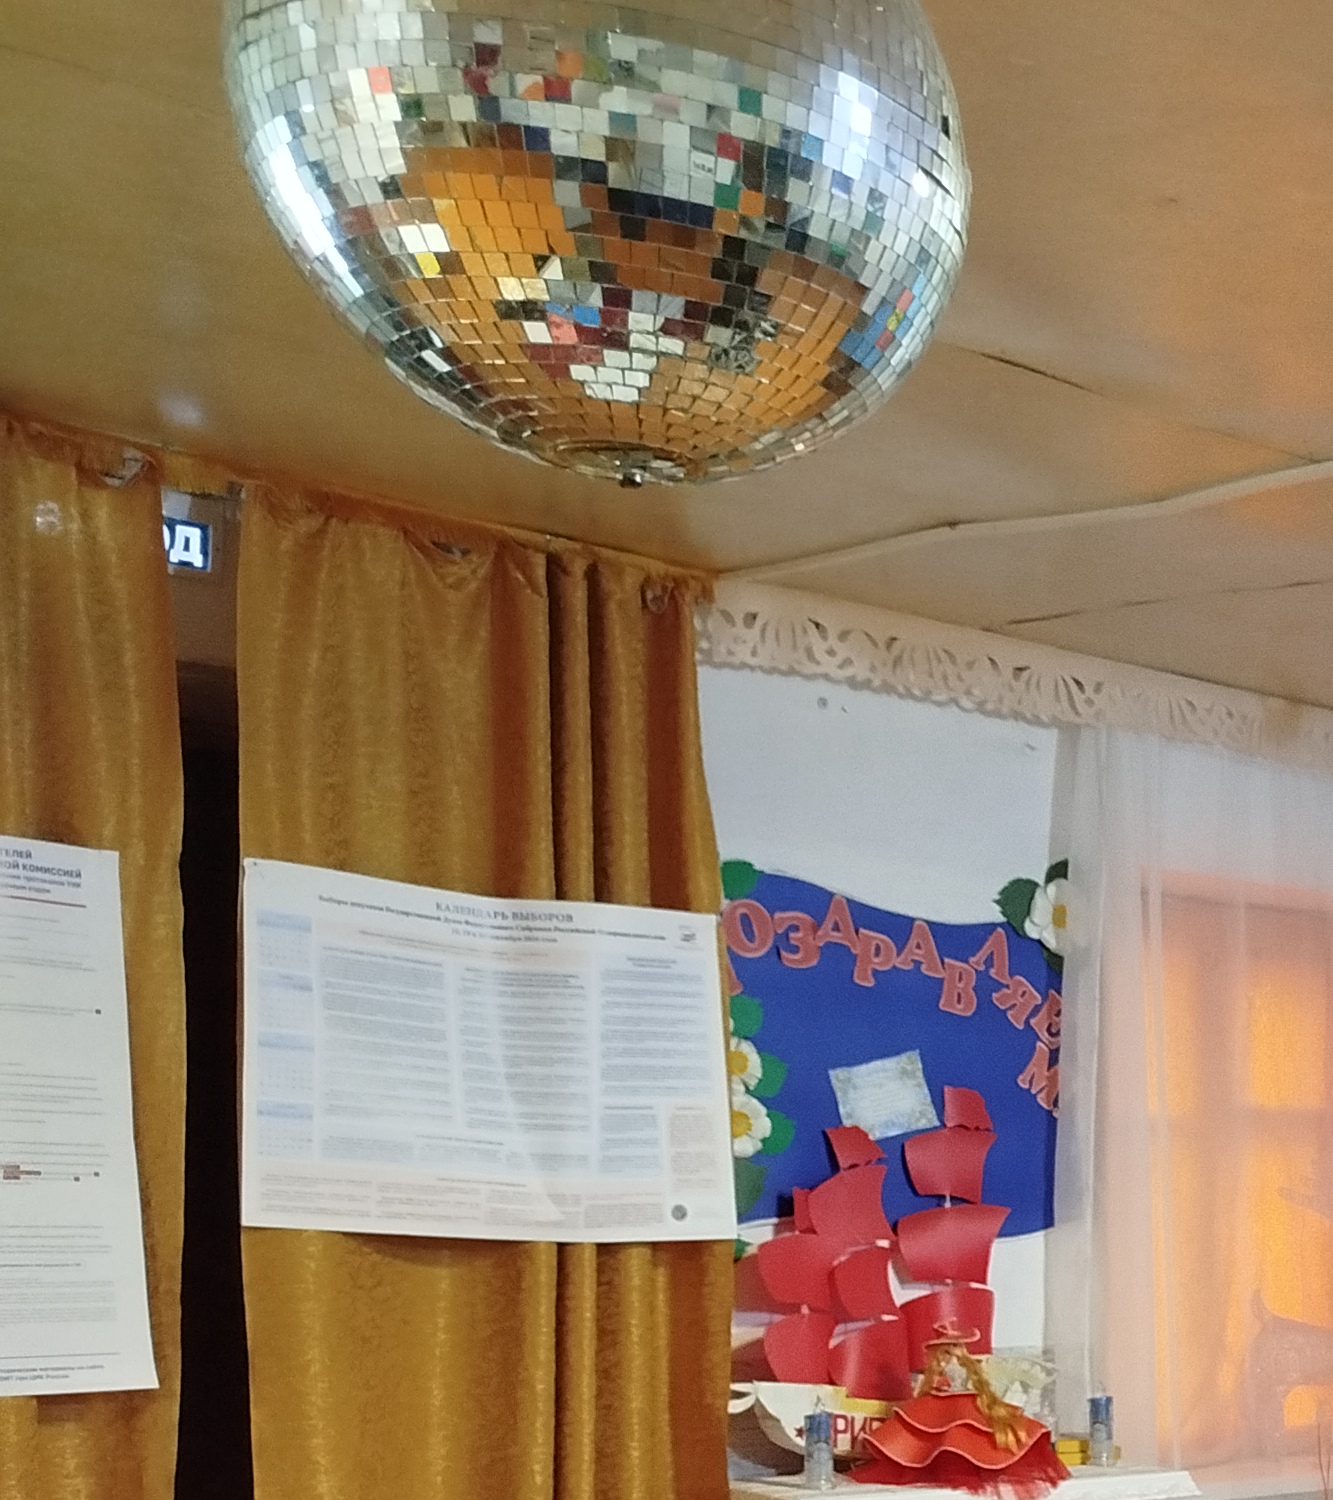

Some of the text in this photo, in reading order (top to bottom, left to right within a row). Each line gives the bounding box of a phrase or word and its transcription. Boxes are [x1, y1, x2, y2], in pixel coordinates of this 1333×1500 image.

[22, 863, 82, 880] КОМИССИЕЙ
[435, 901, 574, 923] КАЛЕНДАРЬ ВЫБОРОВ
[721, 894, 1062, 1118] ОЗДРАВЛЯЕМ
